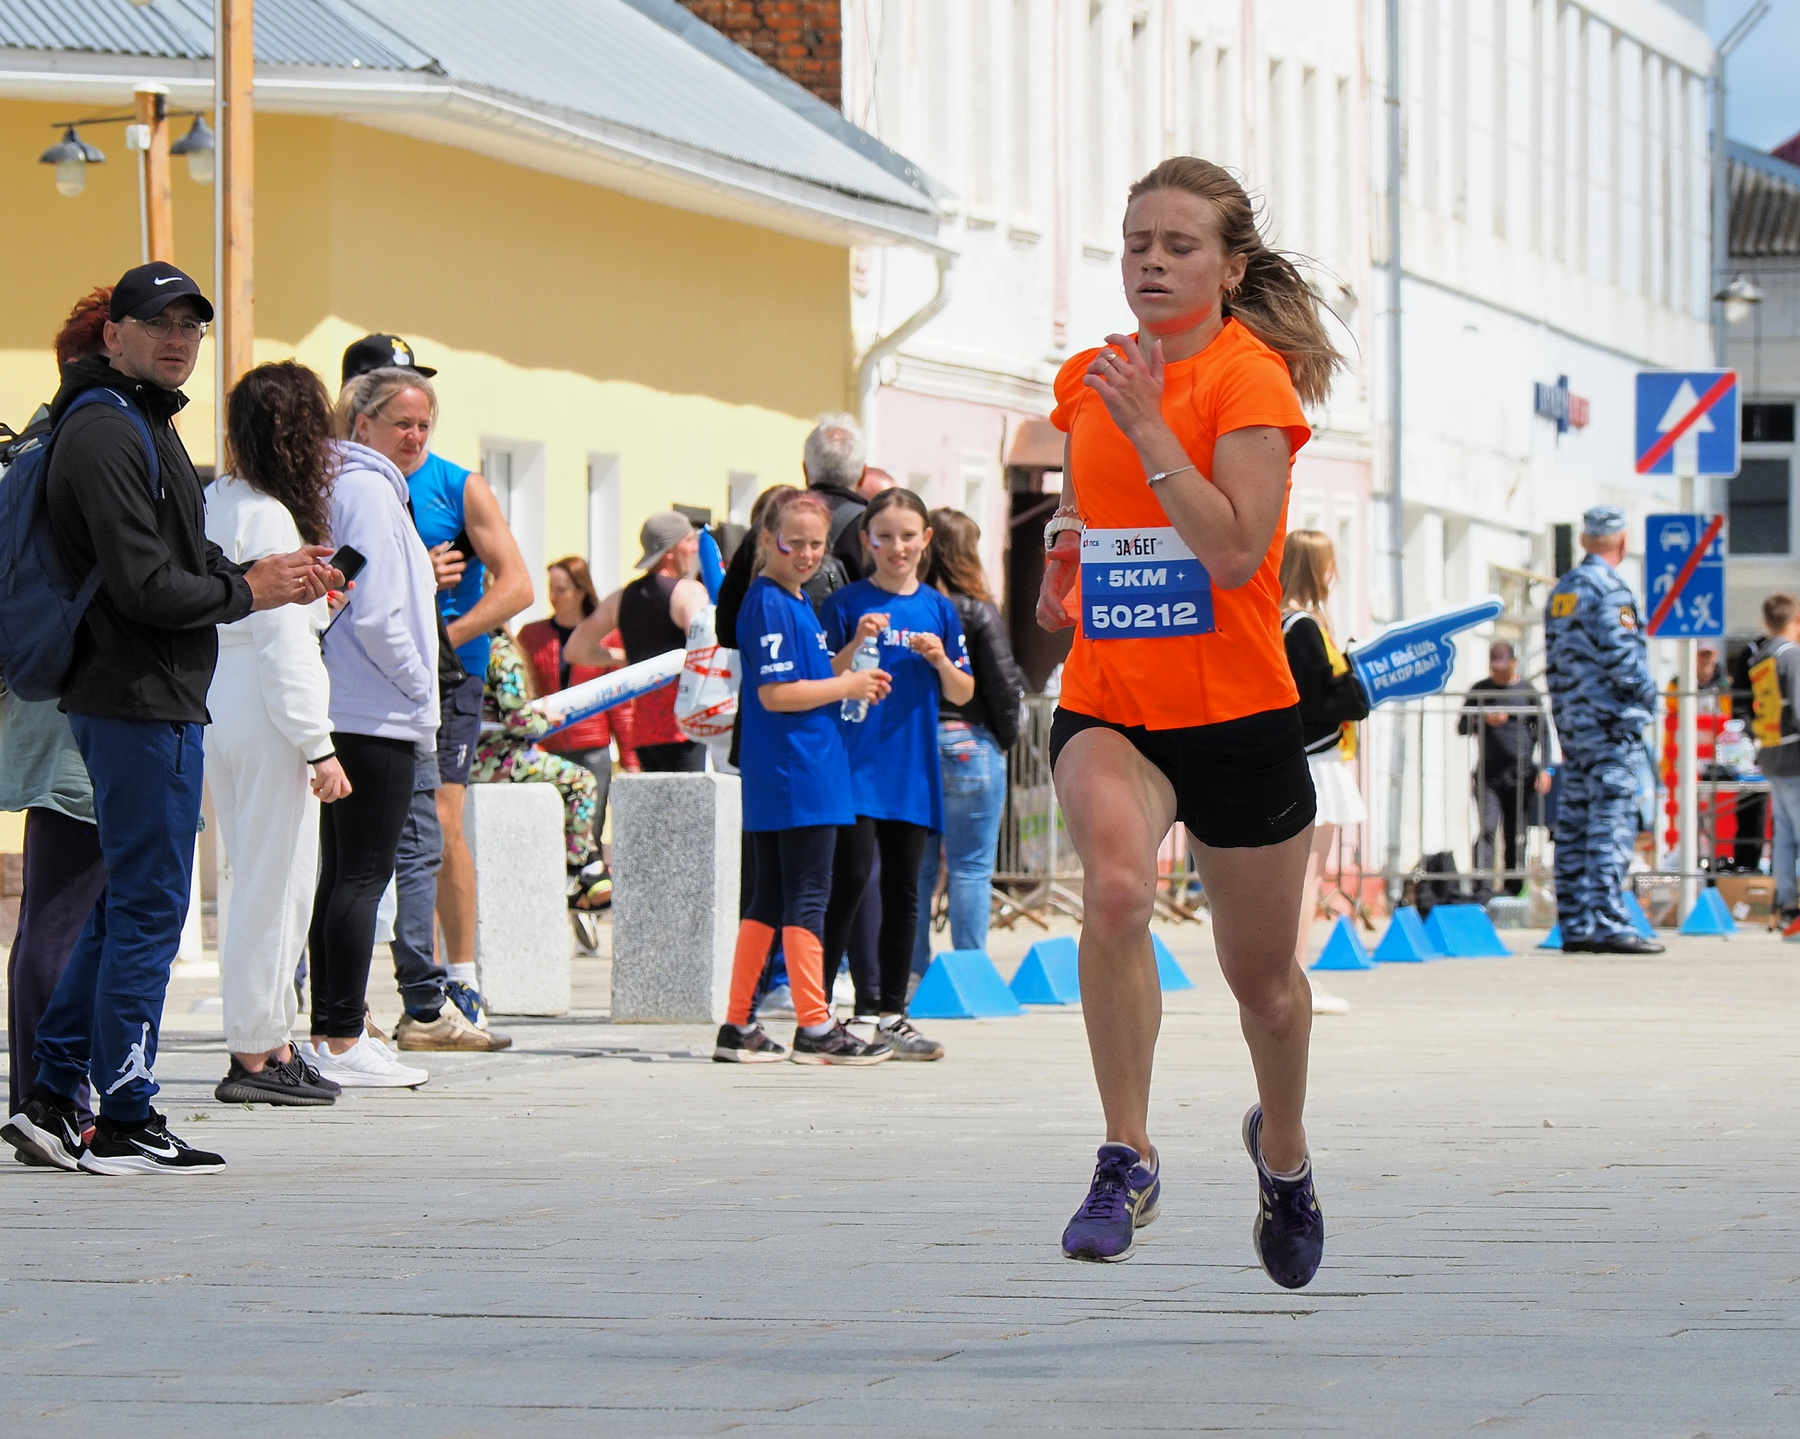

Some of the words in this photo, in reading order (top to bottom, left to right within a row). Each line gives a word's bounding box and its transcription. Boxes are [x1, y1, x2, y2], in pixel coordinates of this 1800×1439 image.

[1108, 568, 1167, 587] 5КМ
[1092, 602, 1198, 629] 50212
[760, 633, 783, 659] 7
[1365, 656, 1390, 676] ТЫ
[1373, 652, 1441, 690] РЕКОРДЫ!
